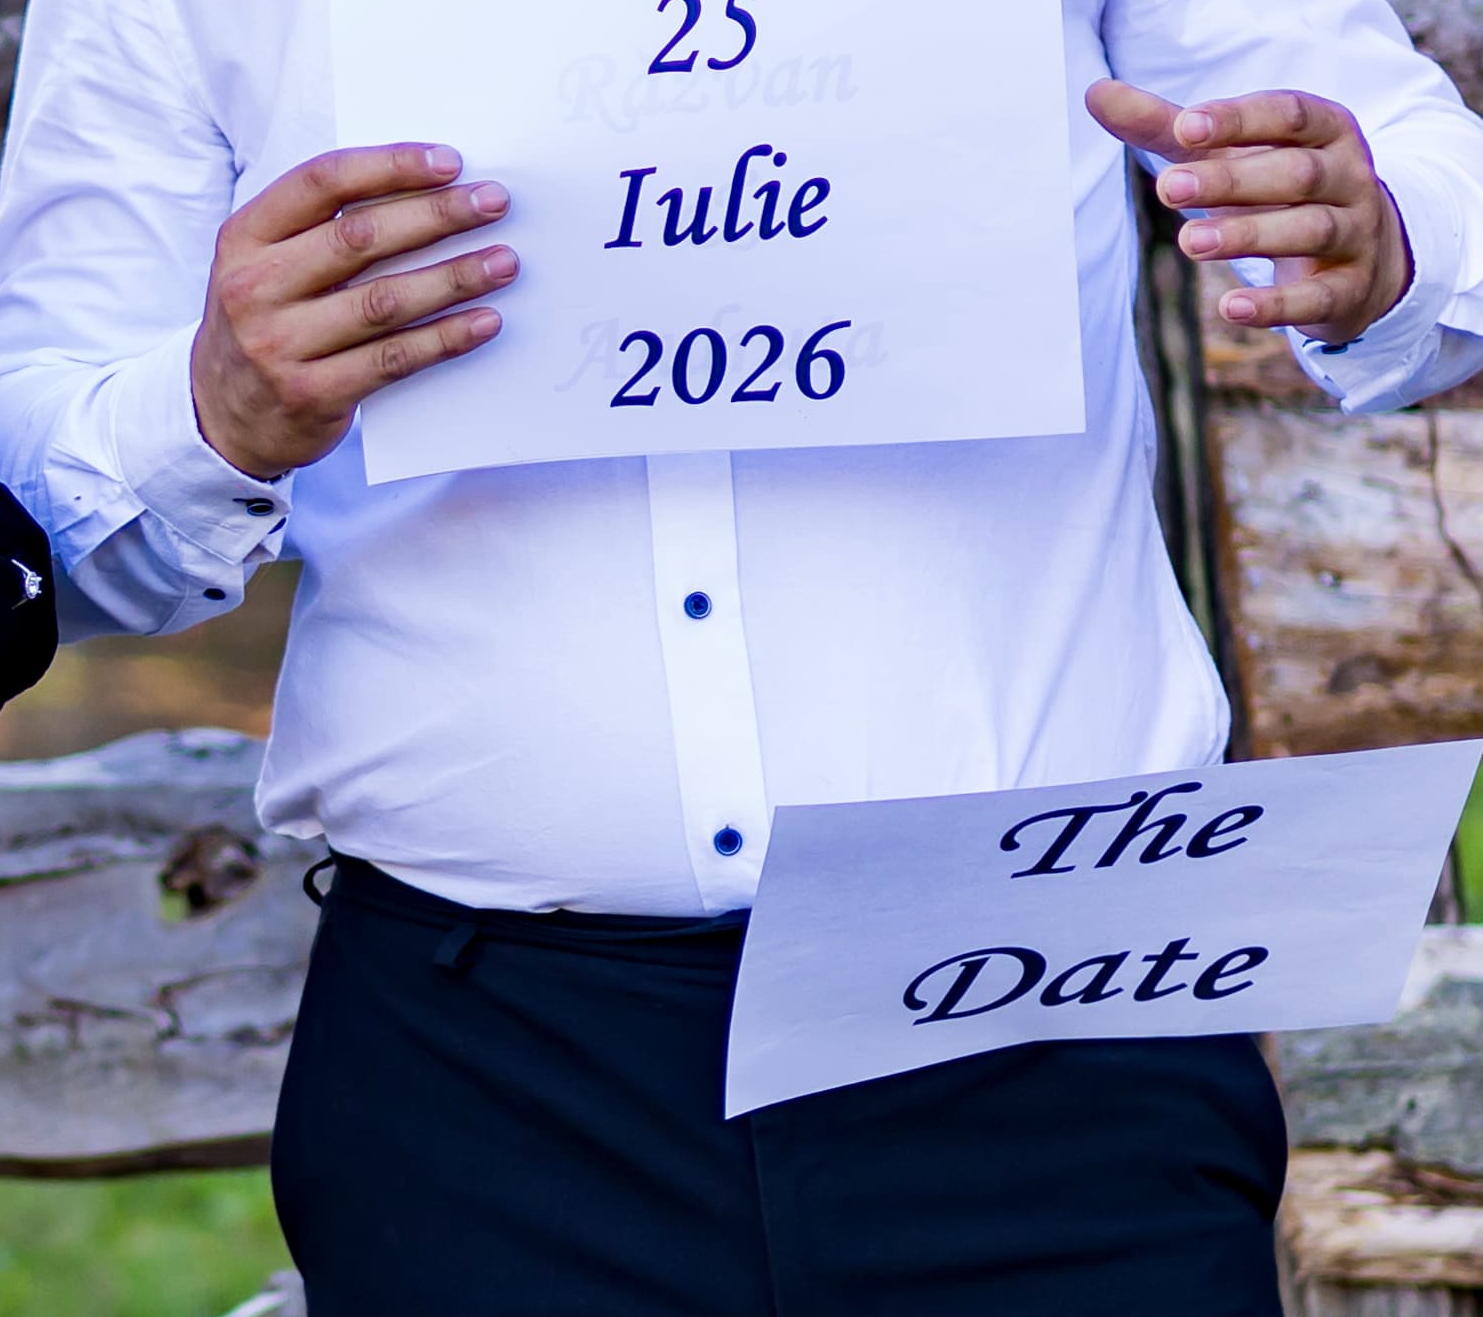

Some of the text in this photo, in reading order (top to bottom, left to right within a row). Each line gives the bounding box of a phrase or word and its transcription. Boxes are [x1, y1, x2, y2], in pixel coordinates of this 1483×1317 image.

[604, 144, 831, 249] Iulie
[610, 320, 852, 408] 2026
[999, 781, 1265, 879] The
[902, 937, 1270, 1026] Date
